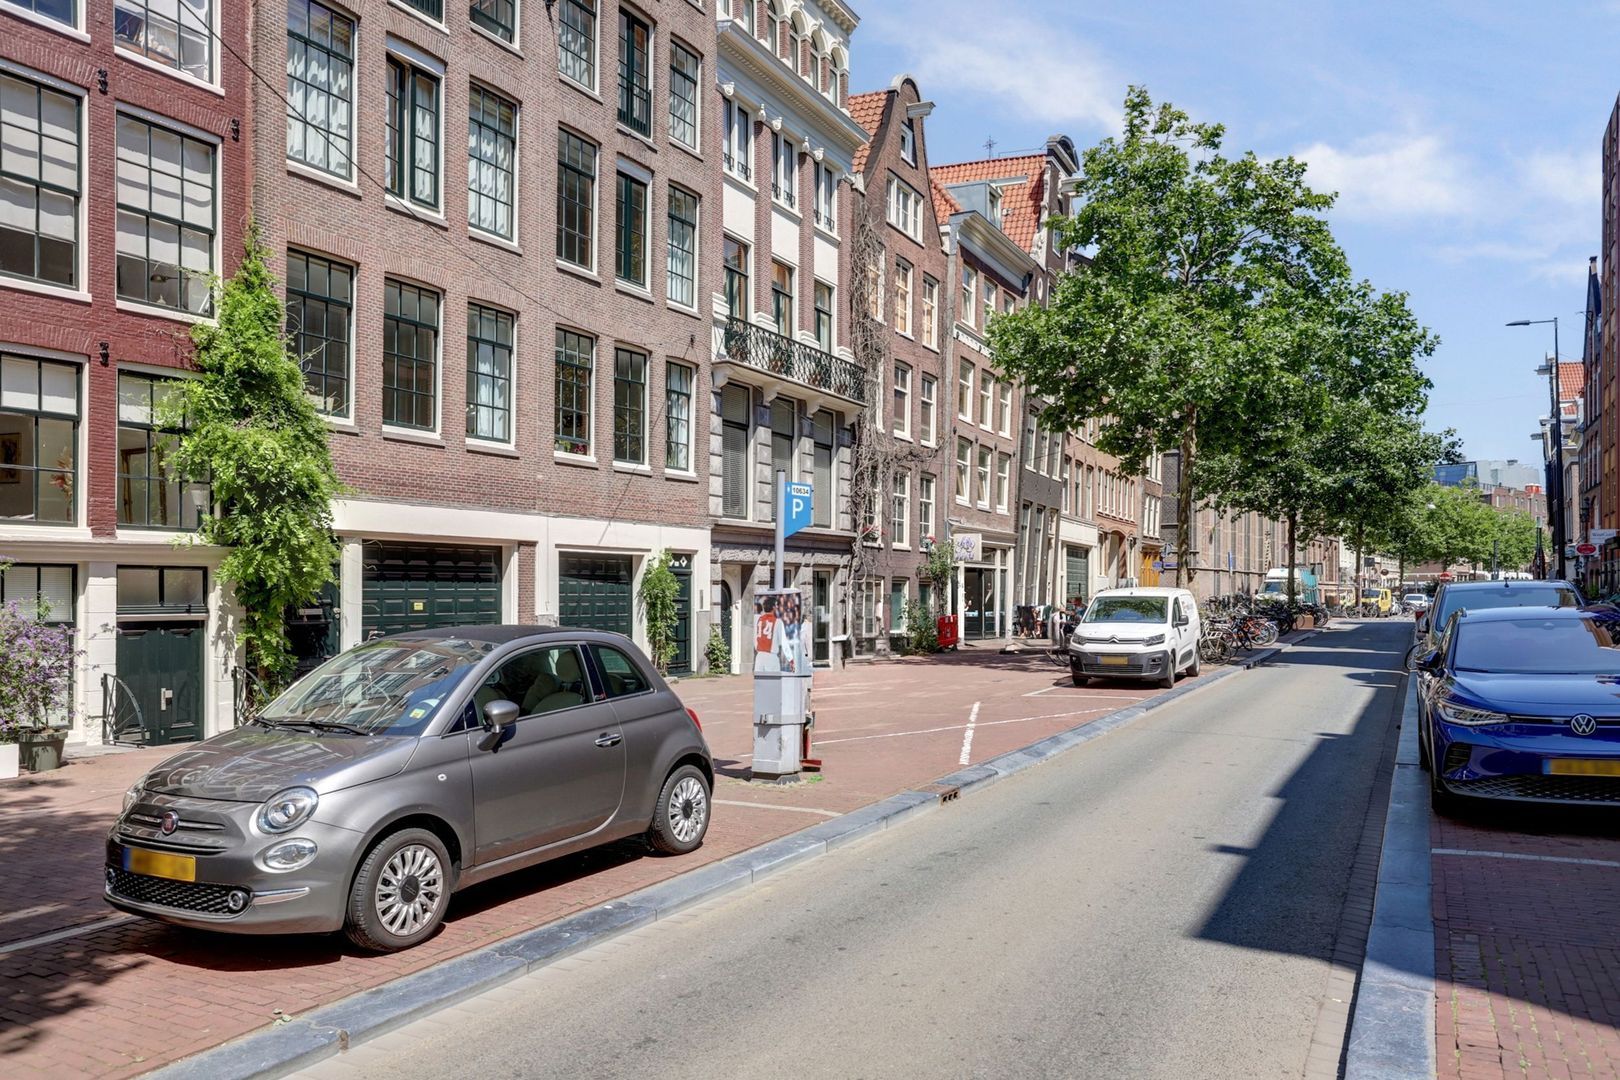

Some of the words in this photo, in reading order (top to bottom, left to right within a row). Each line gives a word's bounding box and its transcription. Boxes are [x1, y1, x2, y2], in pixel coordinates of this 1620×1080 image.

[792, 498, 804, 519] P
[757, 619, 773, 640] 14
[1571, 714, 1596, 735] VW
